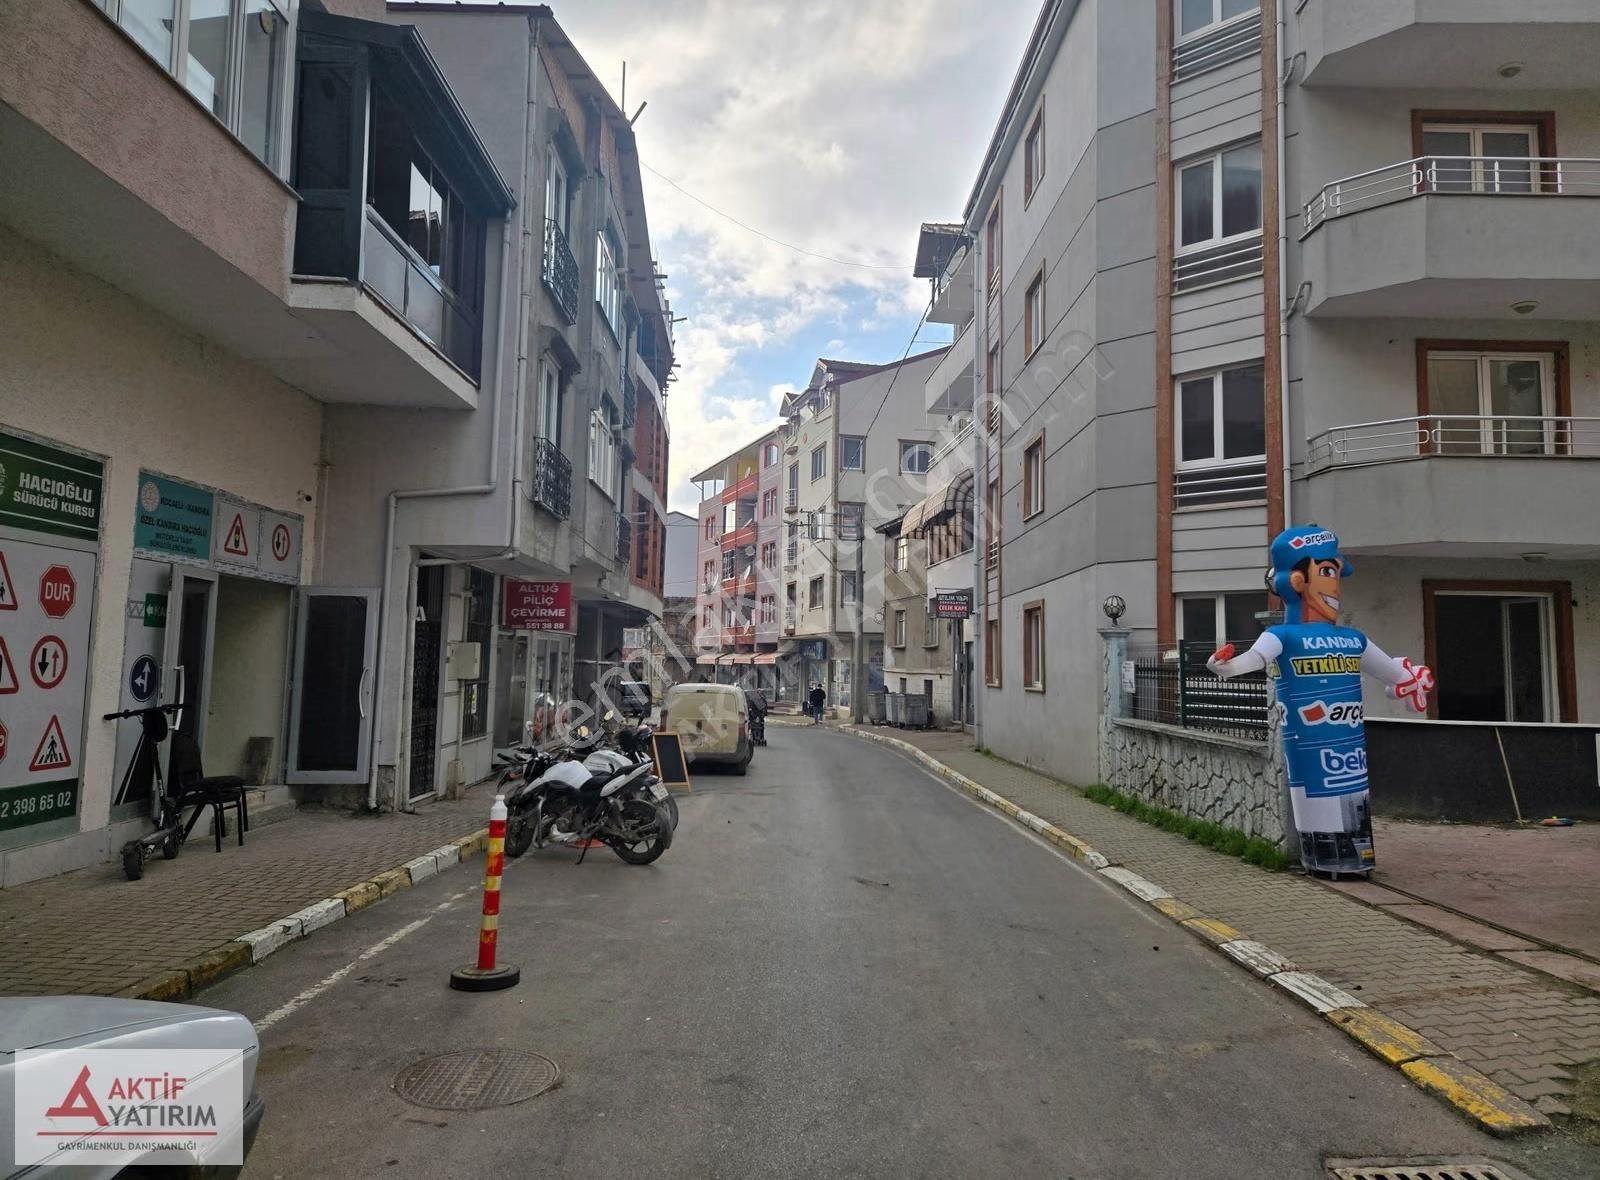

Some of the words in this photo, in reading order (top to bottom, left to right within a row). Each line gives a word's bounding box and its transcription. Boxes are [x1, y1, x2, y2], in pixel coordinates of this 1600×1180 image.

[18, 471, 93, 503] HACIOĞLU
[13, 490, 58, 510] SÜRÜCÜ
[60, 501, 95, 518] KURSU
[45, 582, 71, 602] DUR
[518, 584, 560, 593] ALTUĞ
[523, 595, 555, 606] PİLİÇ
[511, 606, 567, 618] ÇEVİRME
[1294, 656, 1344, 676] YETKİLİ
[13, 798, 36, 815] 398
[40, 794, 54, 810] 65
[57, 791, 71, 807] 02
